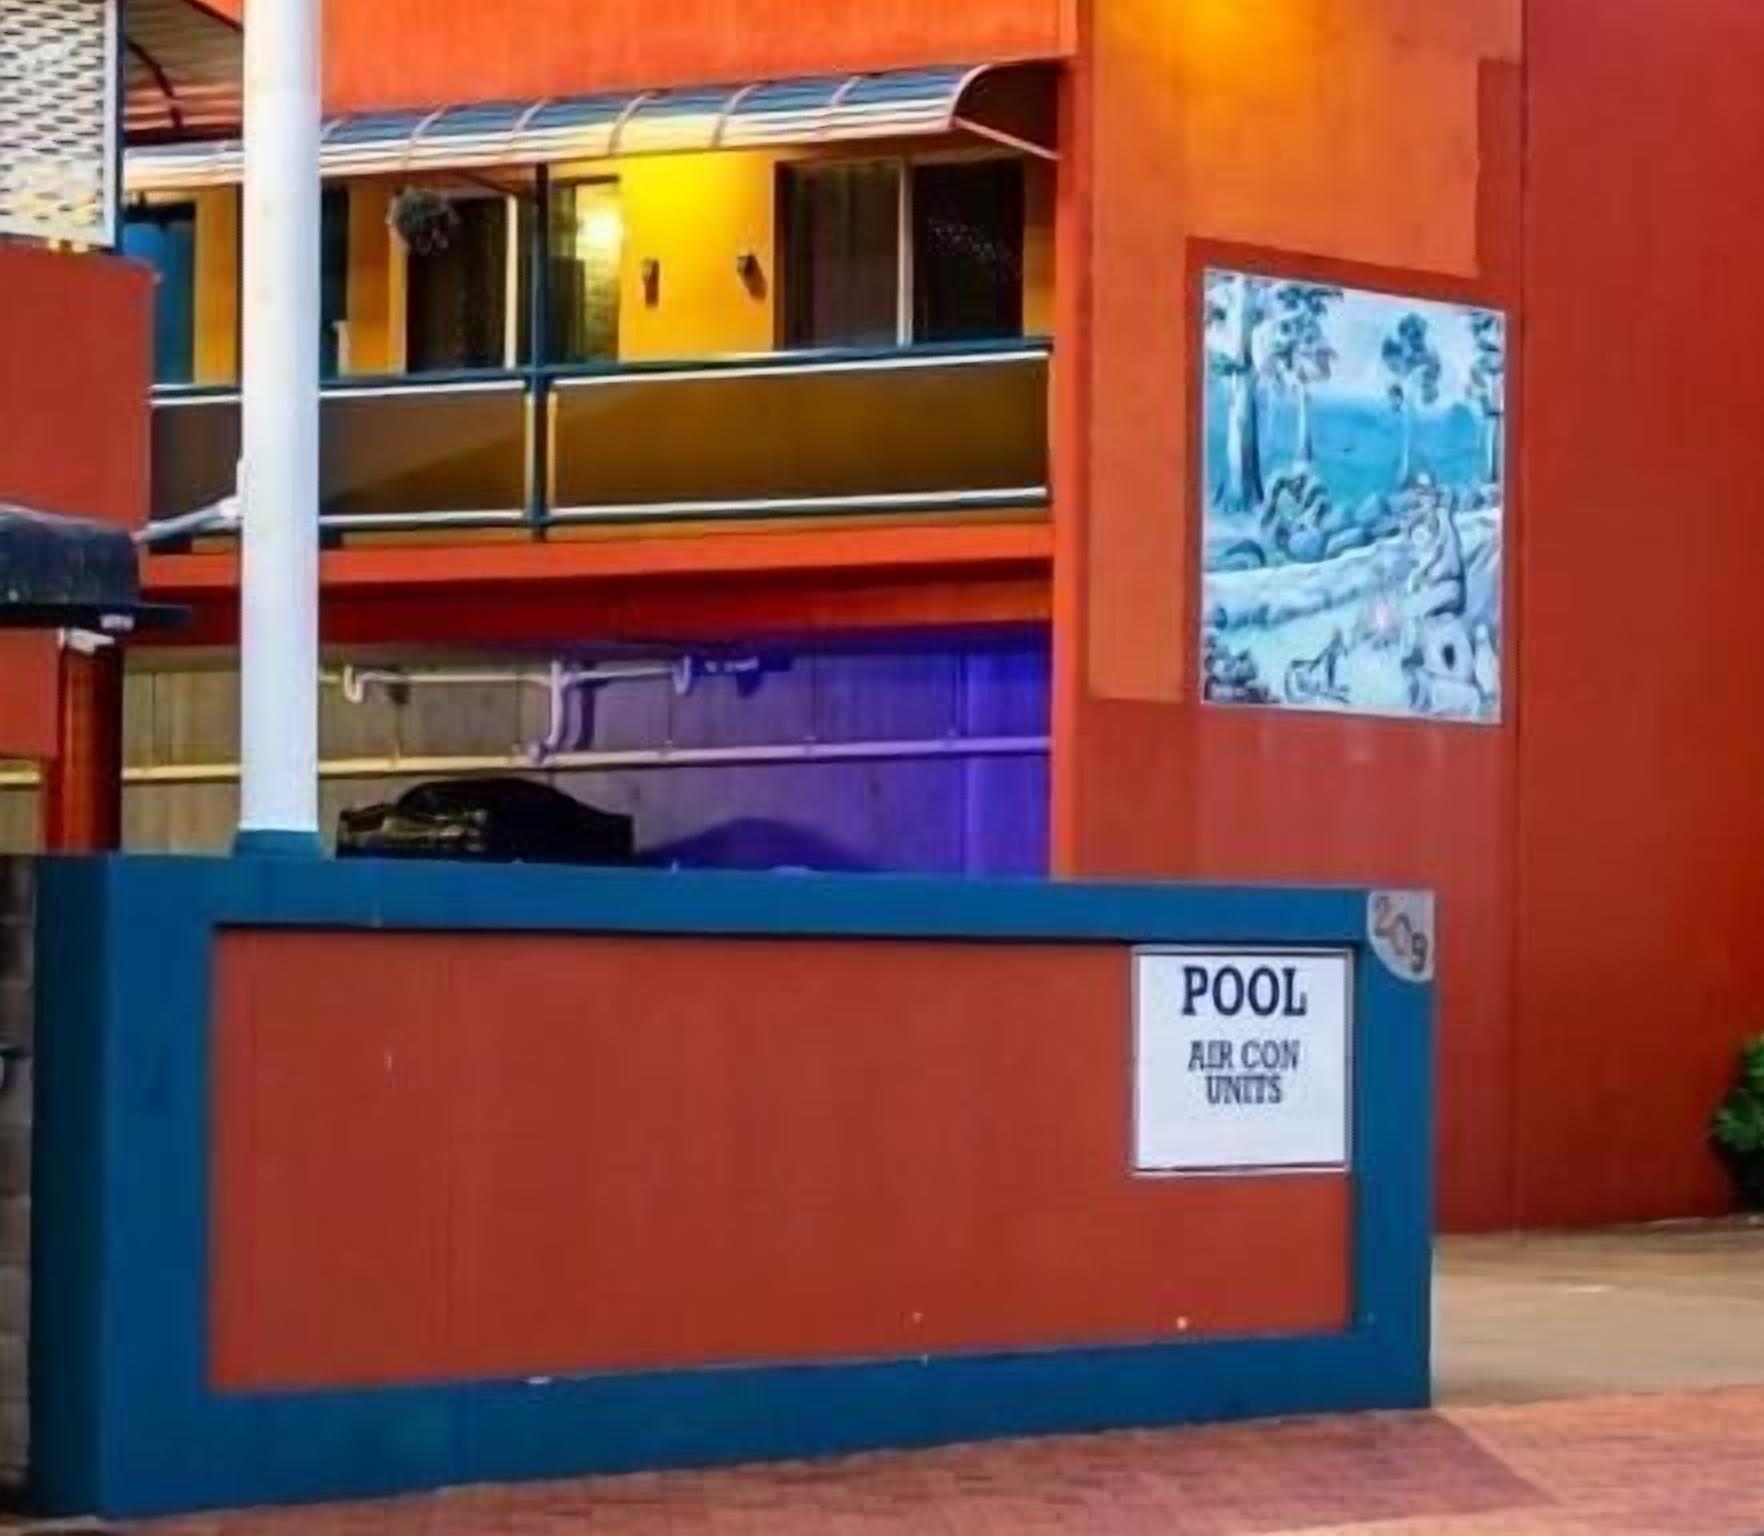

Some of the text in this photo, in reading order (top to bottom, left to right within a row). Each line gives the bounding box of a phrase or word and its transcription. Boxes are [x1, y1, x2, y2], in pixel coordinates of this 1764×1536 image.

[1181, 965, 1307, 1016] POOL
[1188, 1039, 1300, 1071] AIR CON
[1205, 1075, 1282, 1104] UNITS
